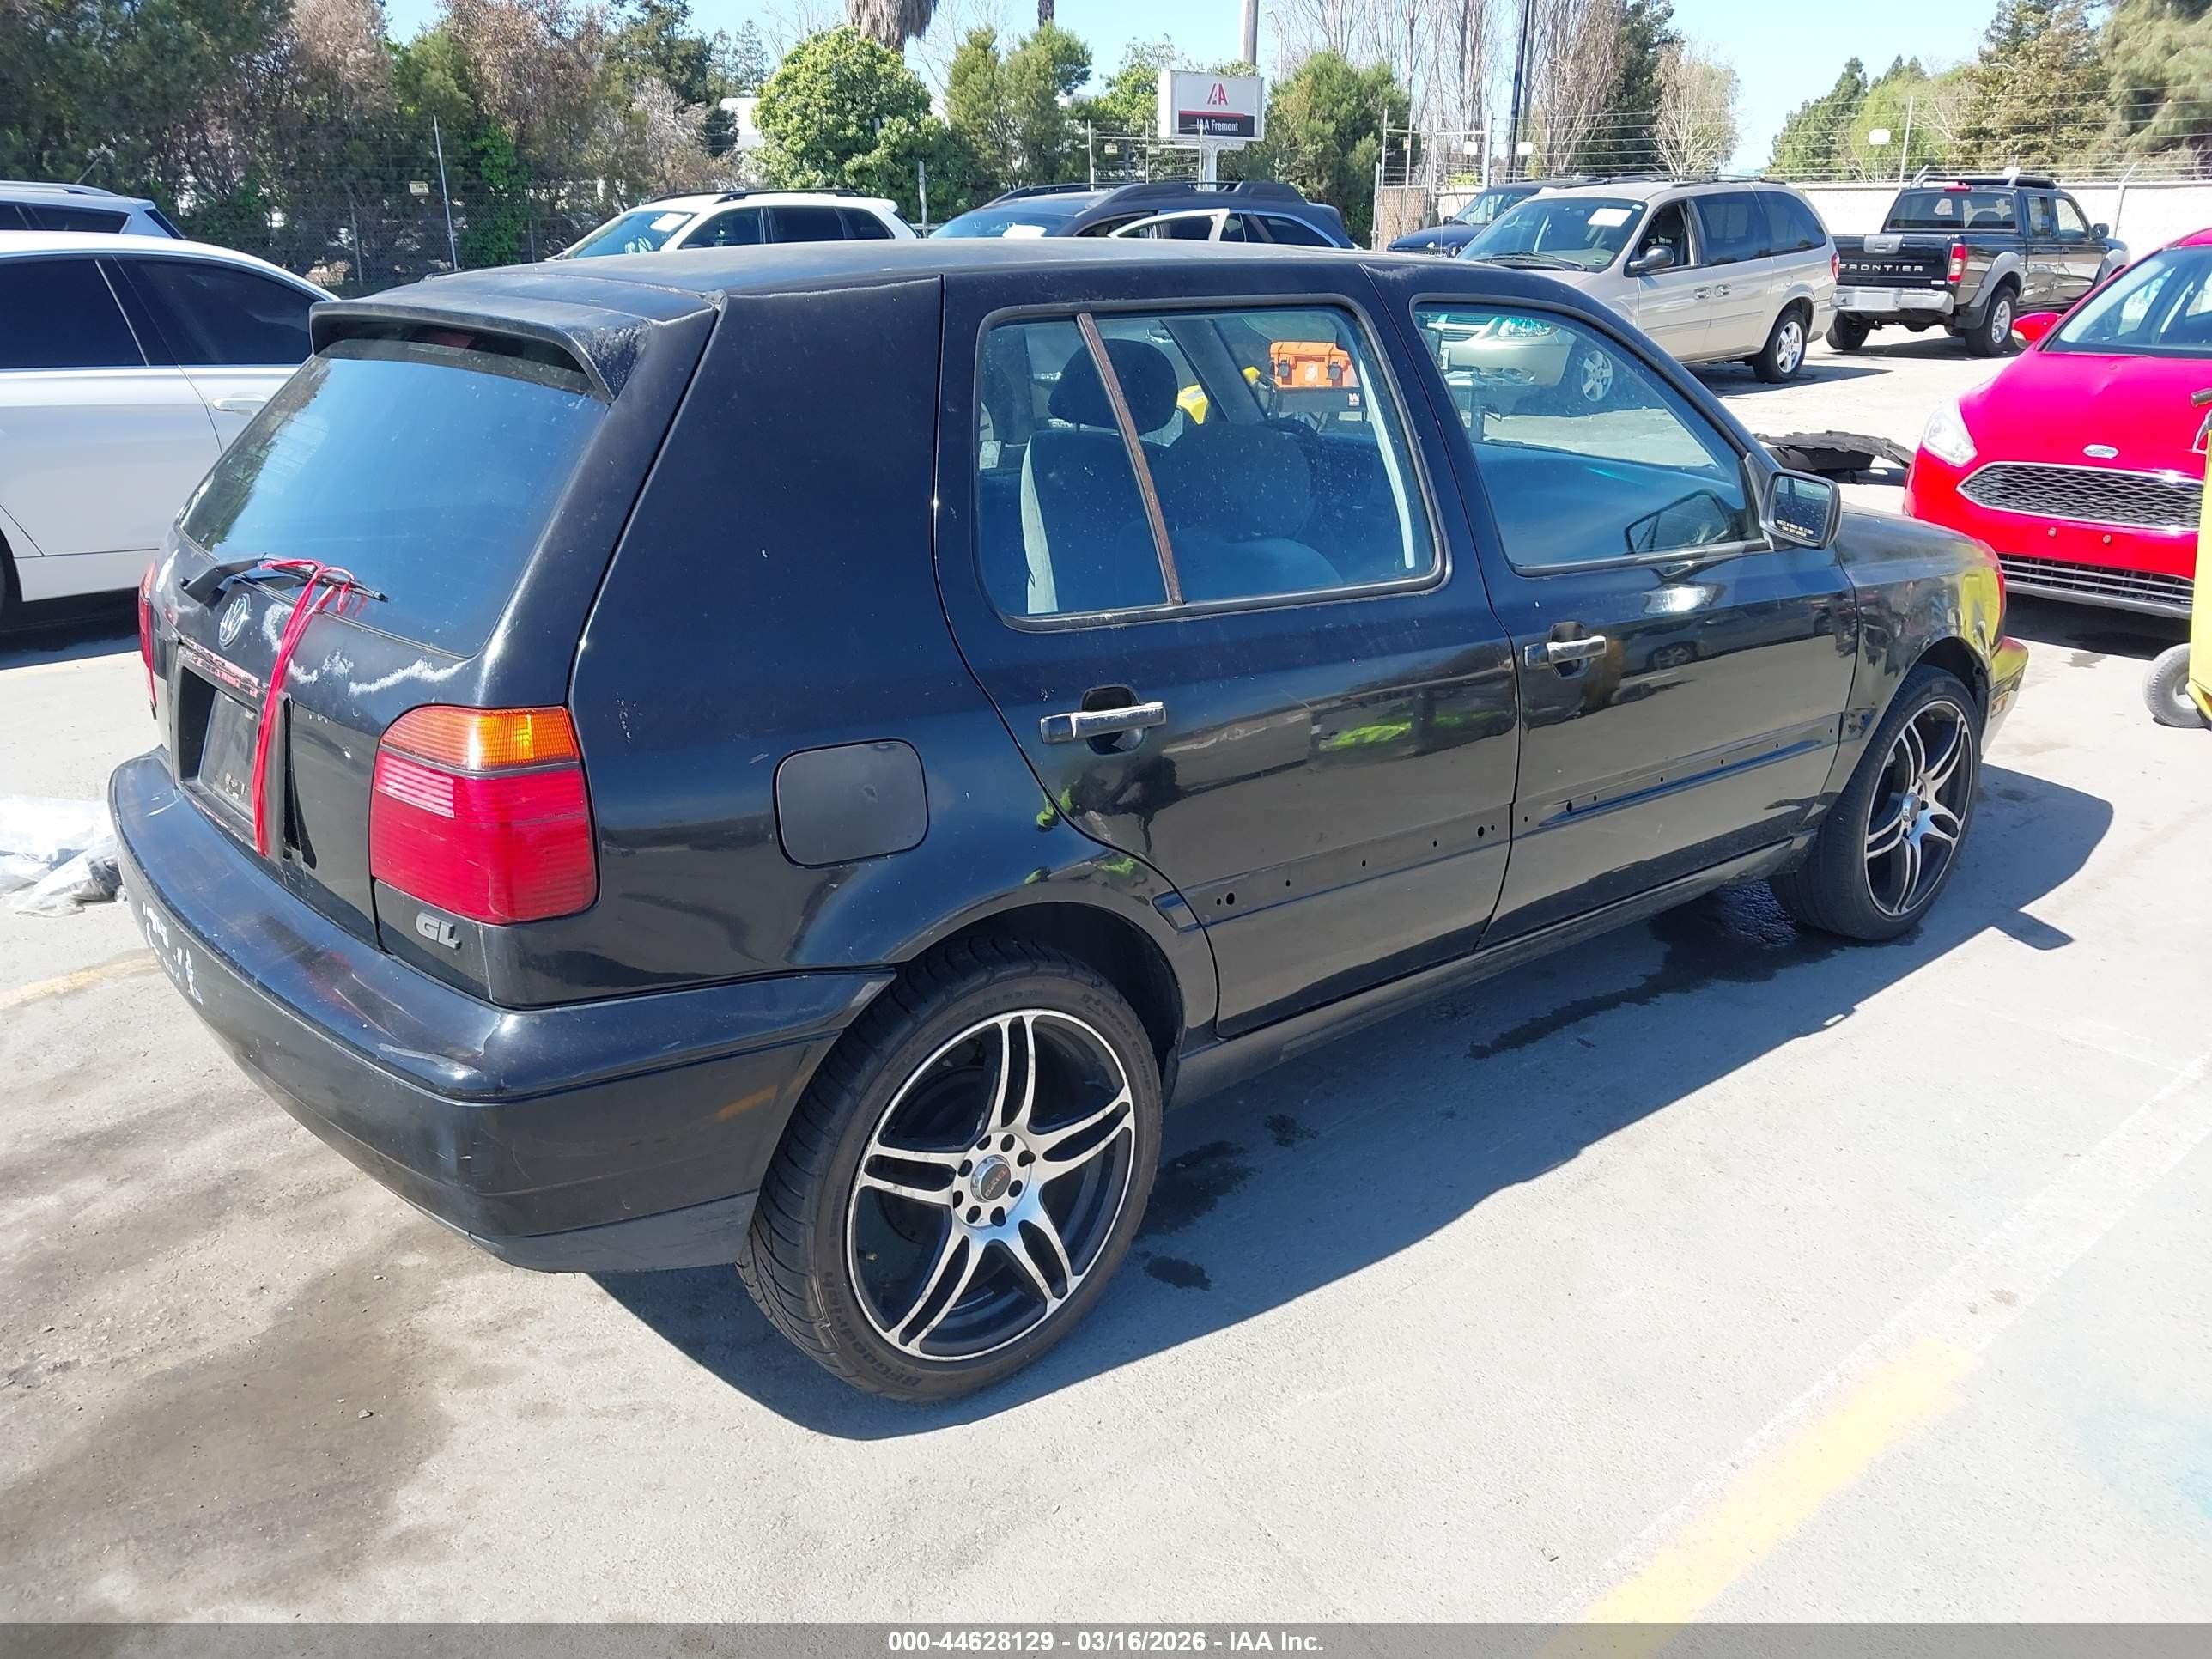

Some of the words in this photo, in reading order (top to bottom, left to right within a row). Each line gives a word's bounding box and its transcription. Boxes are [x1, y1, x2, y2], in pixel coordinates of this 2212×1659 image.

[1211, 119, 1239, 131] Fremont
[1838, 264, 1923, 272] FRONTIER
[416, 911, 462, 950] GL
